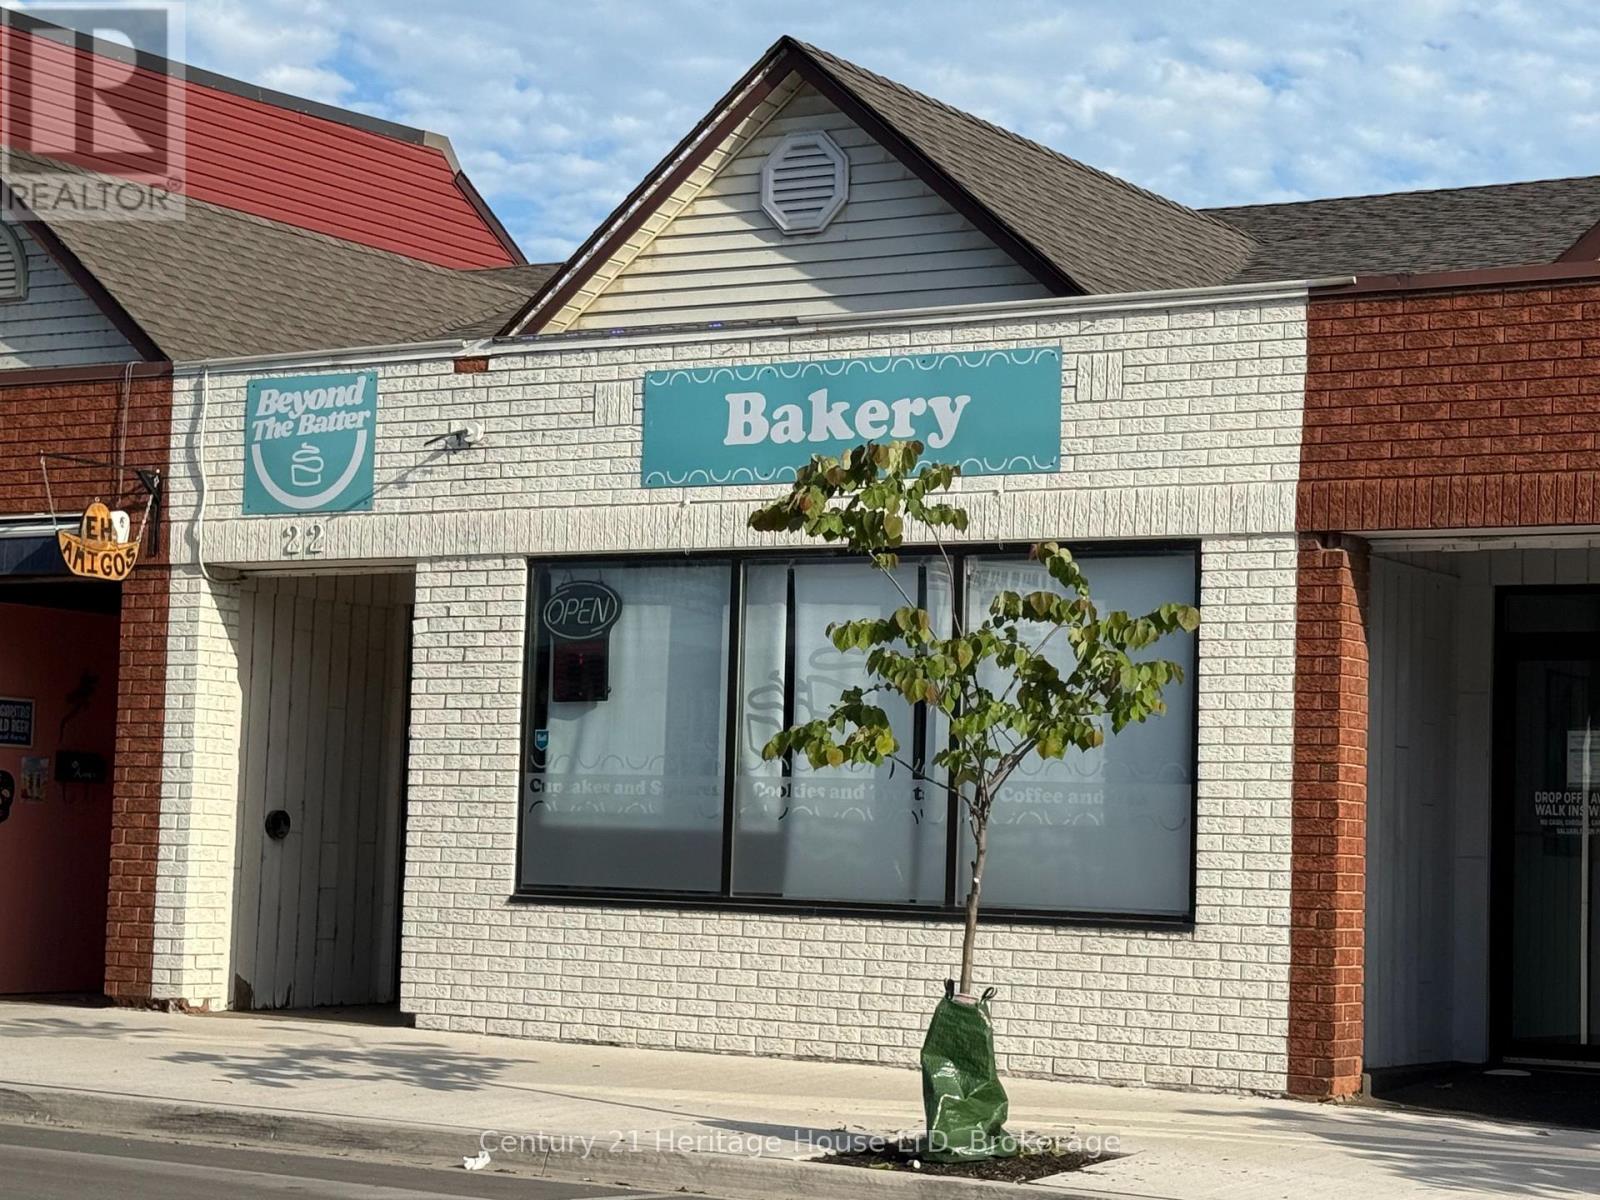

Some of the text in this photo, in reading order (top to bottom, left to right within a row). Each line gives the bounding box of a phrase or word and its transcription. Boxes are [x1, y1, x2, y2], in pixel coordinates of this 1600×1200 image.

[256, 375, 367, 420] Beyond
[252, 409, 372, 442] The Batter
[723, 388, 971, 449] Bakery
[86, 515, 113, 541] EH
[282, 524, 324, 555] 22
[63, 540, 136, 577] AMIGOS
[547, 597, 610, 625] OPEN
[614, 779, 646, 795] and
[829, 783, 865, 800] and
[999, 787, 1104, 806] Coffee and
[1535, 791, 1562, 804] DROP
[1563, 791, 1583, 804] OFF
[1535, 803, 1566, 816] WALK
